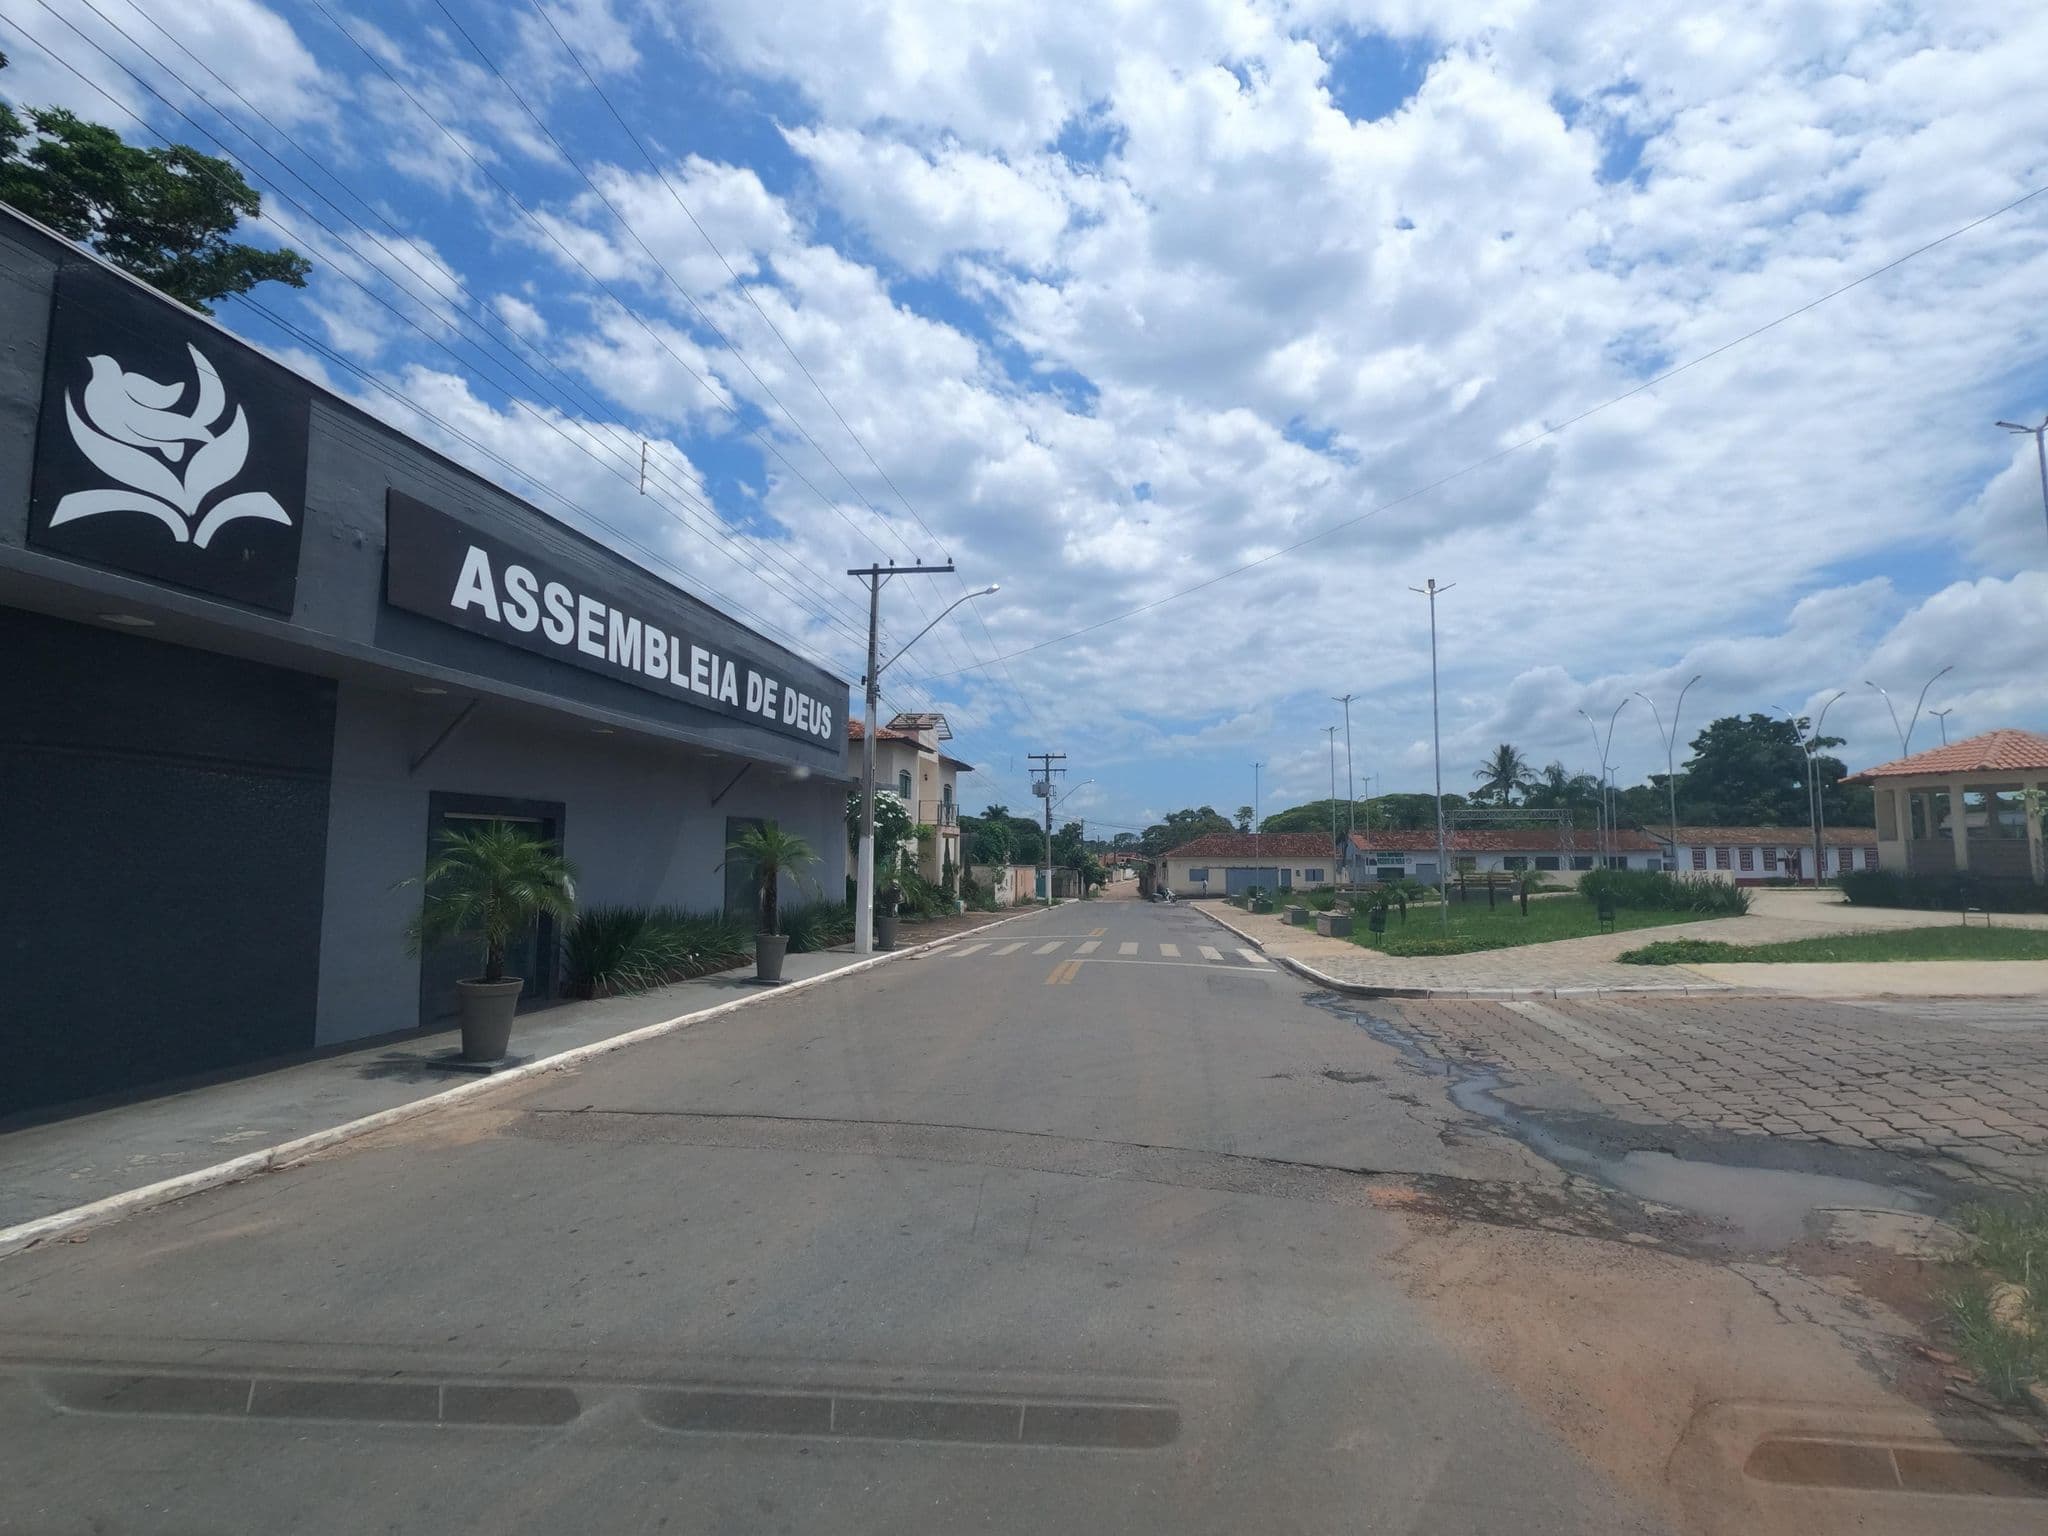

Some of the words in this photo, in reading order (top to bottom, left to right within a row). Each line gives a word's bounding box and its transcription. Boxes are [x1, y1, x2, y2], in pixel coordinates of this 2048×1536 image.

[451, 545, 739, 707] ASSEMBLEIA
[746, 670, 778, 719] DE
[782, 686, 832, 739] DEUS
